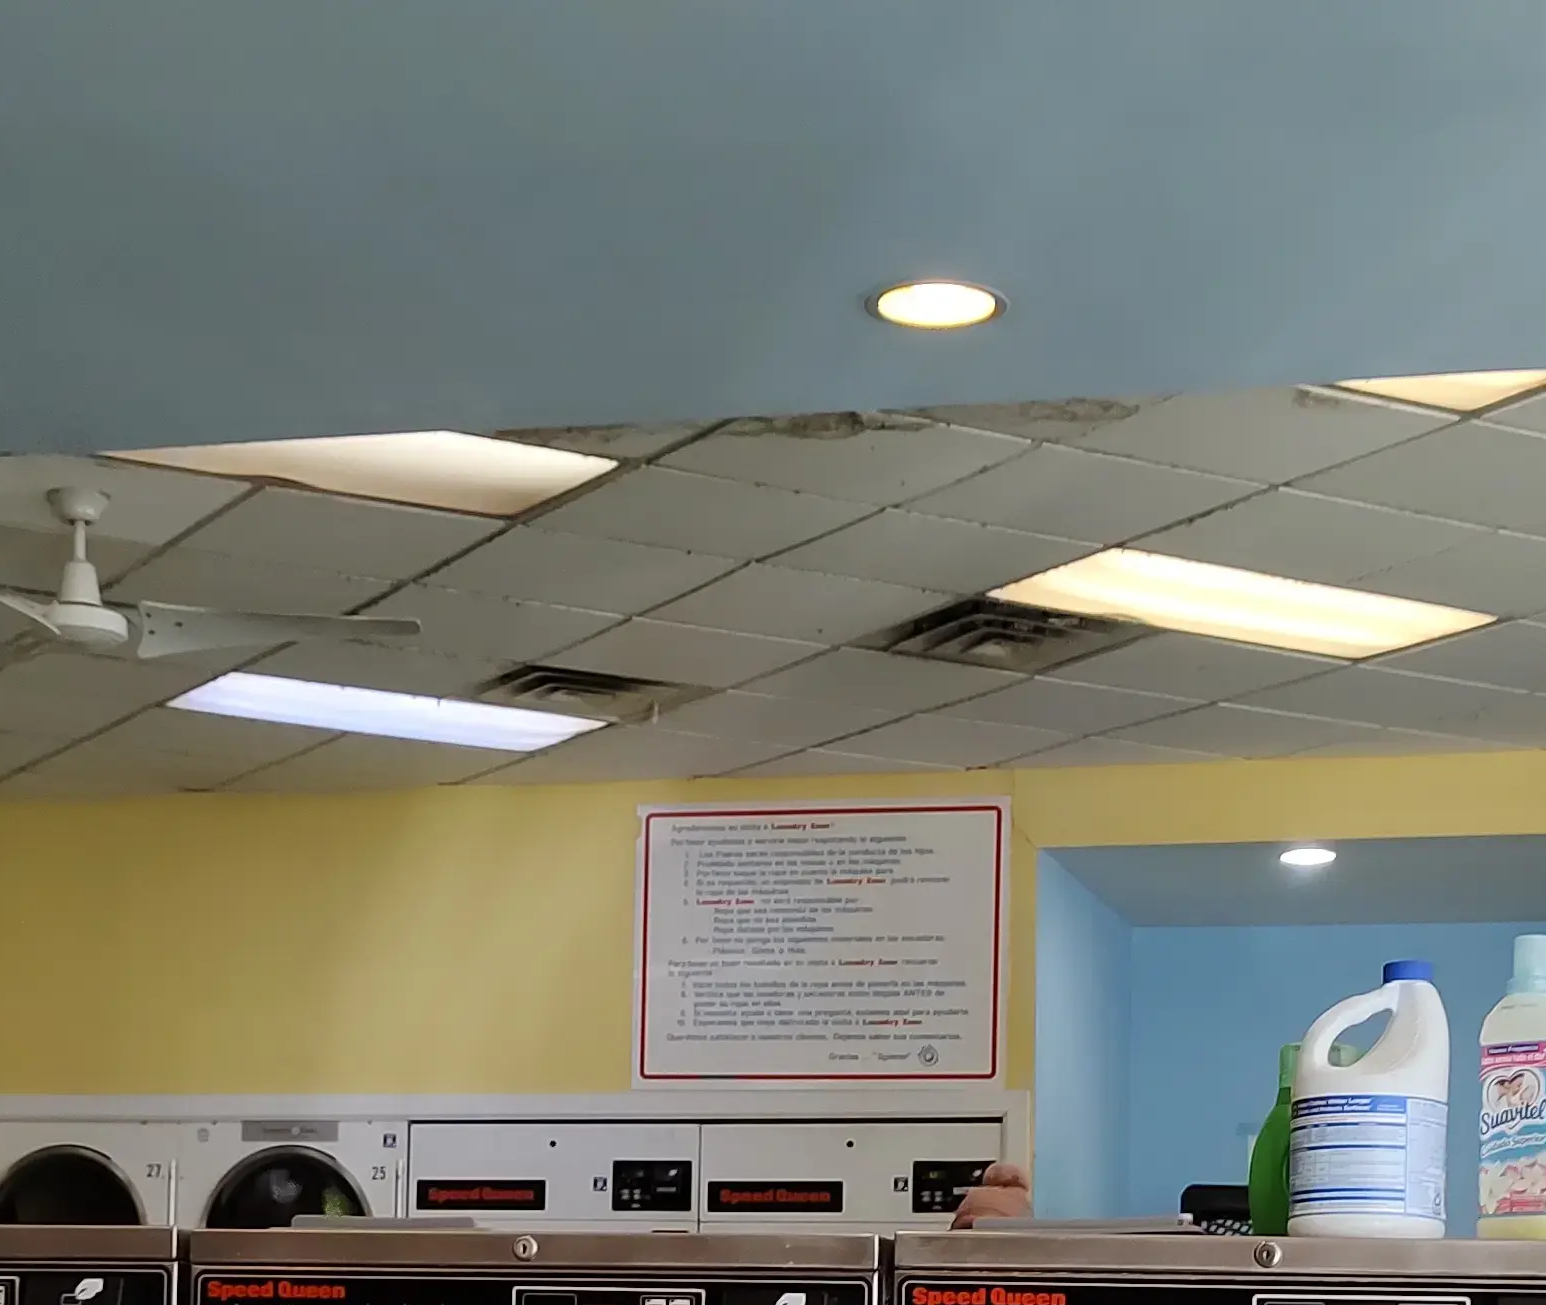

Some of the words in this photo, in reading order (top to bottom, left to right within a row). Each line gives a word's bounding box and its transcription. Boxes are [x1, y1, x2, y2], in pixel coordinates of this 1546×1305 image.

[145, 1162, 162, 1179] 27
[370, 1165, 387, 1182] 25
[207, 1280, 274, 1301] Speed
[277, 1280, 346, 1299] Queen
